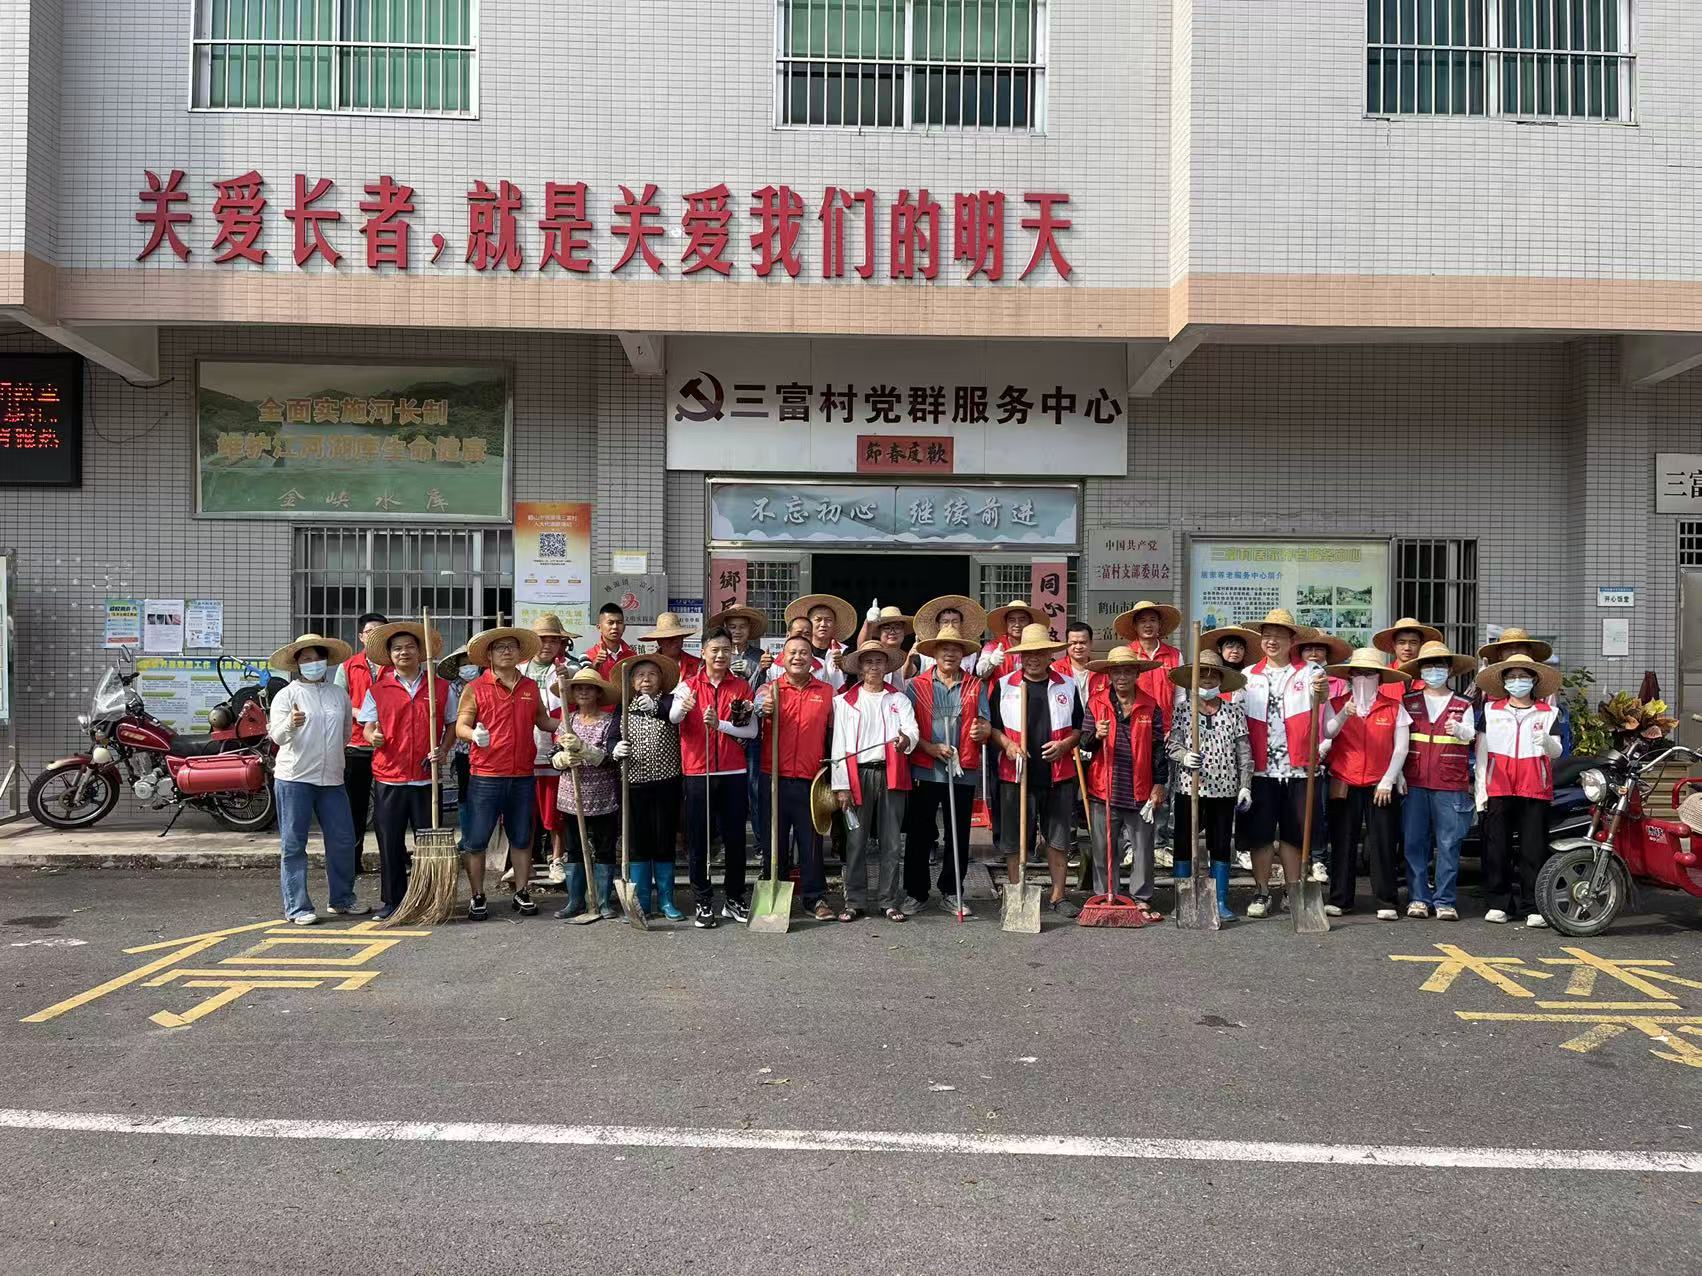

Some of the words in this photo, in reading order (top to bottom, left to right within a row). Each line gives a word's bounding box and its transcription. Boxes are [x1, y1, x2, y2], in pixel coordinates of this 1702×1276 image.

[257, 397, 449, 425] 全面实施河长制
[730, 381, 1123, 425] 三富村党群服务中心
[216, 431, 488, 464] 维护江河湖库生命健康
[751, 496, 878, 525] 不忘初心
[909, 497, 1039, 529] 继续前进
[1105, 539, 1158, 551] 中国共产党
[1097, 563, 1170, 580] 三富村支部委员会
